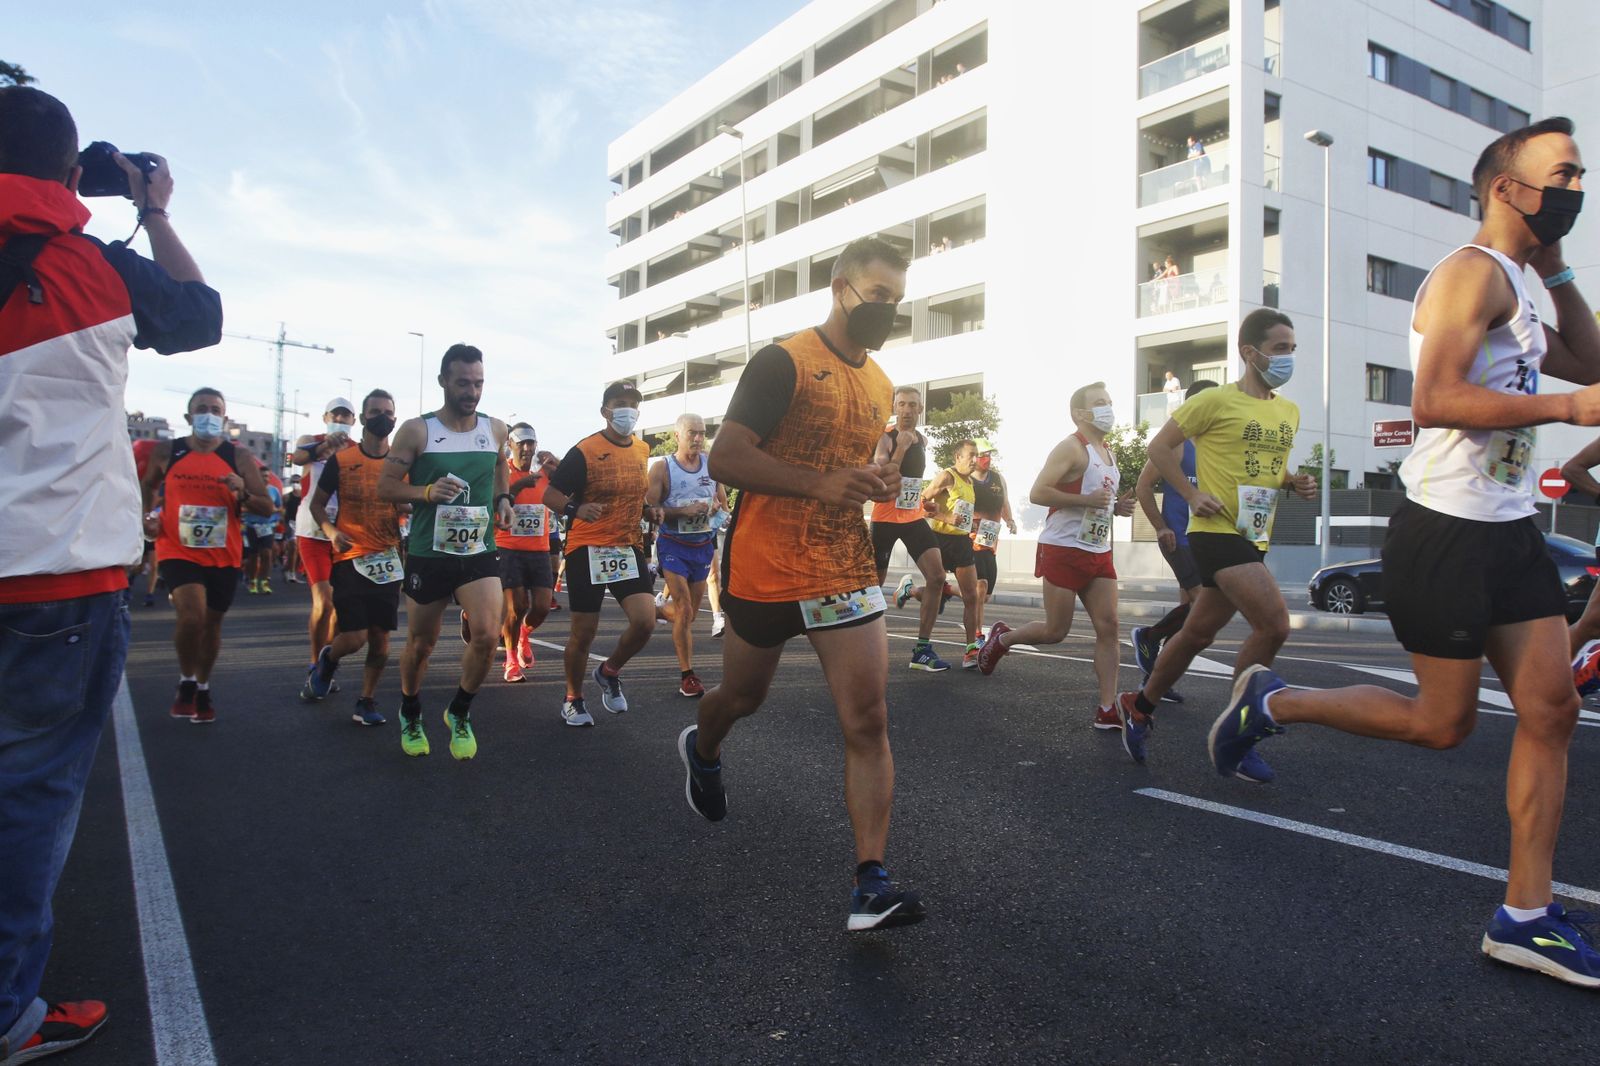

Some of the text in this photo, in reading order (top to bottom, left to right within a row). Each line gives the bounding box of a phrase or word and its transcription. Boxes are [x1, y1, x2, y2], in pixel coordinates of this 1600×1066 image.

[518, 518, 540, 529] 429
[1253, 512, 1268, 528] 89
[193, 525, 214, 538] 67
[446, 528, 479, 543] 204
[1088, 522, 1109, 538] 165
[365, 561, 394, 577] 216
[600, 558, 628, 573] 196
